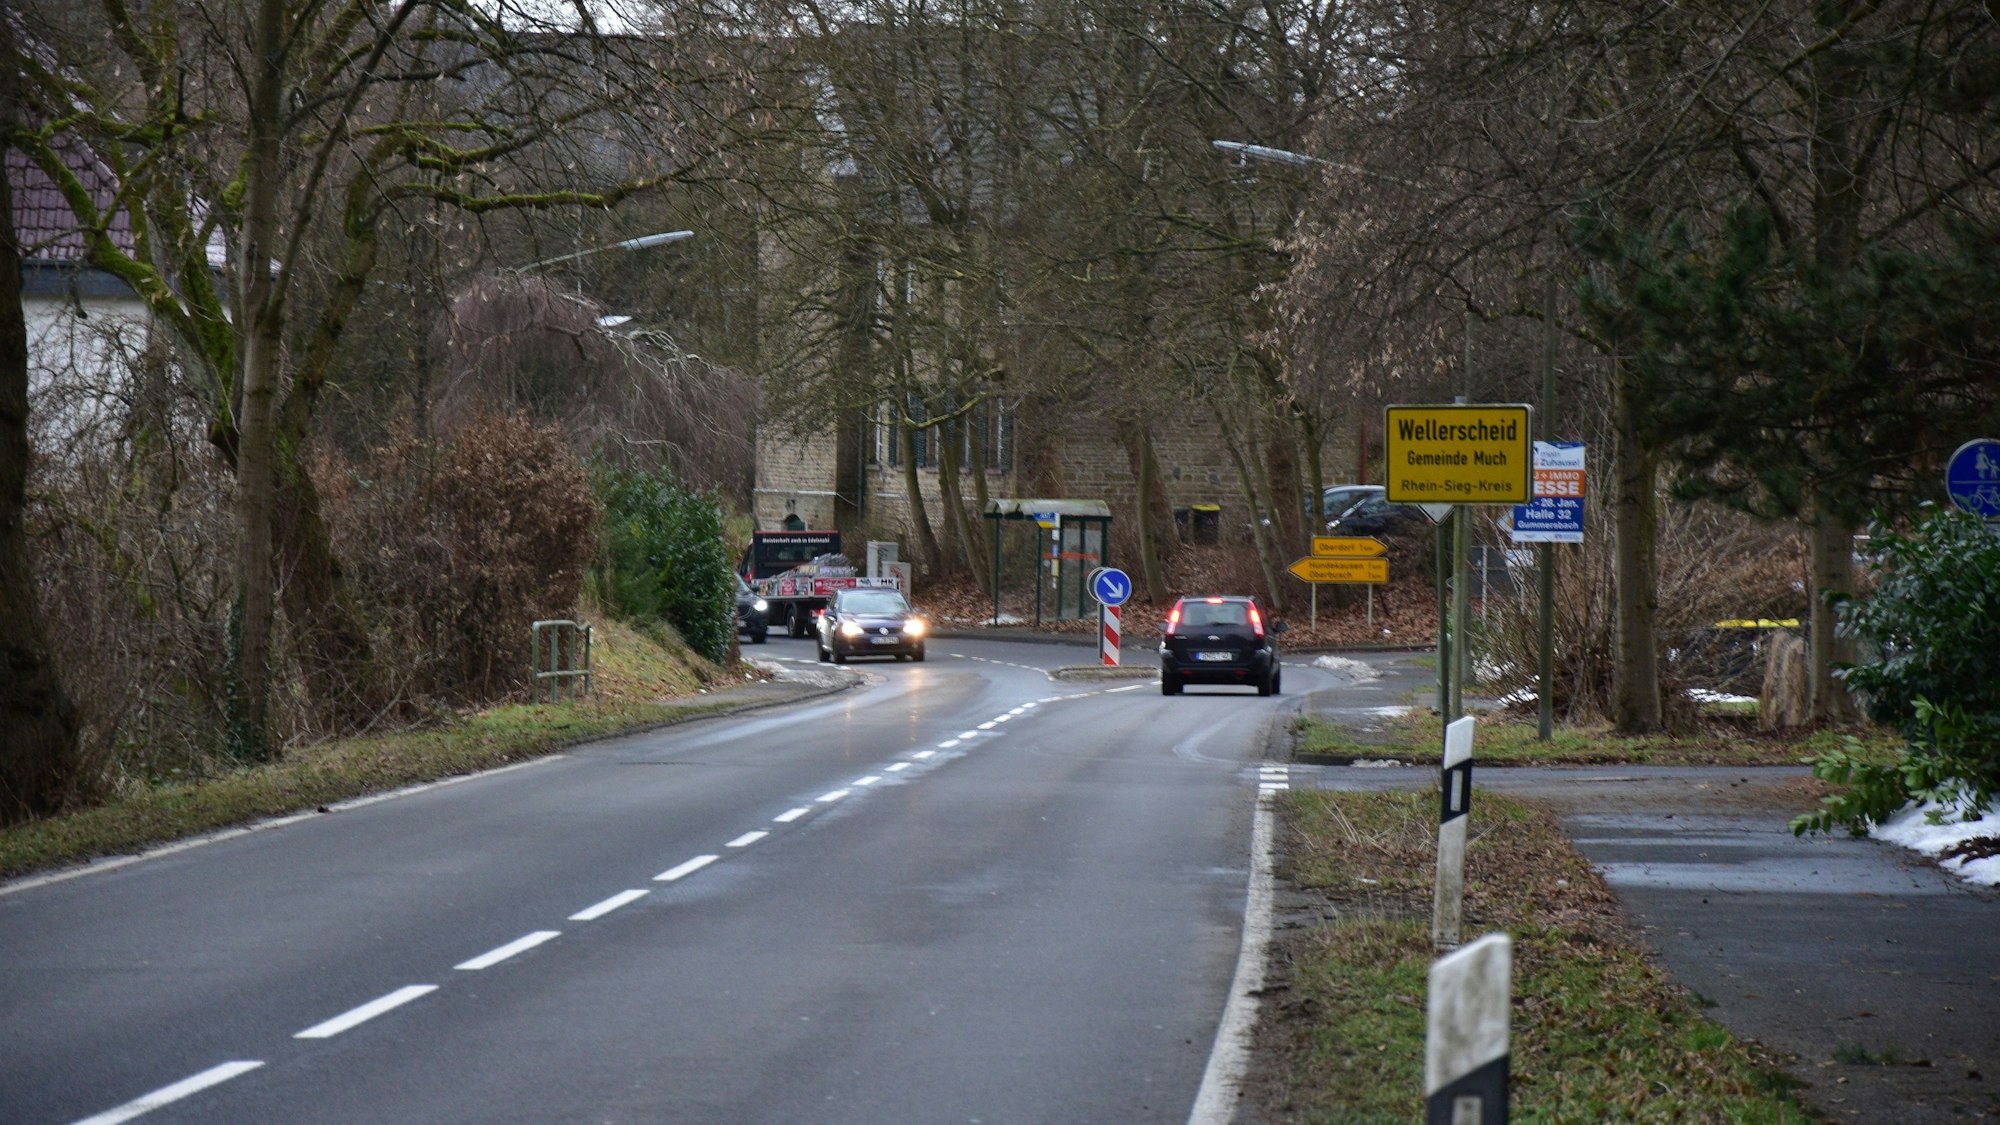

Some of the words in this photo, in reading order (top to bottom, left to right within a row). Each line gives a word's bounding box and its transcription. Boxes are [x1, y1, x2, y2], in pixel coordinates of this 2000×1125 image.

[1398, 419, 1517, 441] Wellerscheid
[1407, 450, 1468, 466] Gemeinde
[1474, 450, 1507, 466] Much
[1549, 471, 1580, 480] IMMO
[1401, 480, 1513, 494] Rhein-Sieg-Kreis
[1533, 480, 1580, 496] ESSE
[1525, 508, 1555, 520] Halle
[1557, 508, 1572, 520] 32
[1517, 520, 1579, 530] Gummersbach
